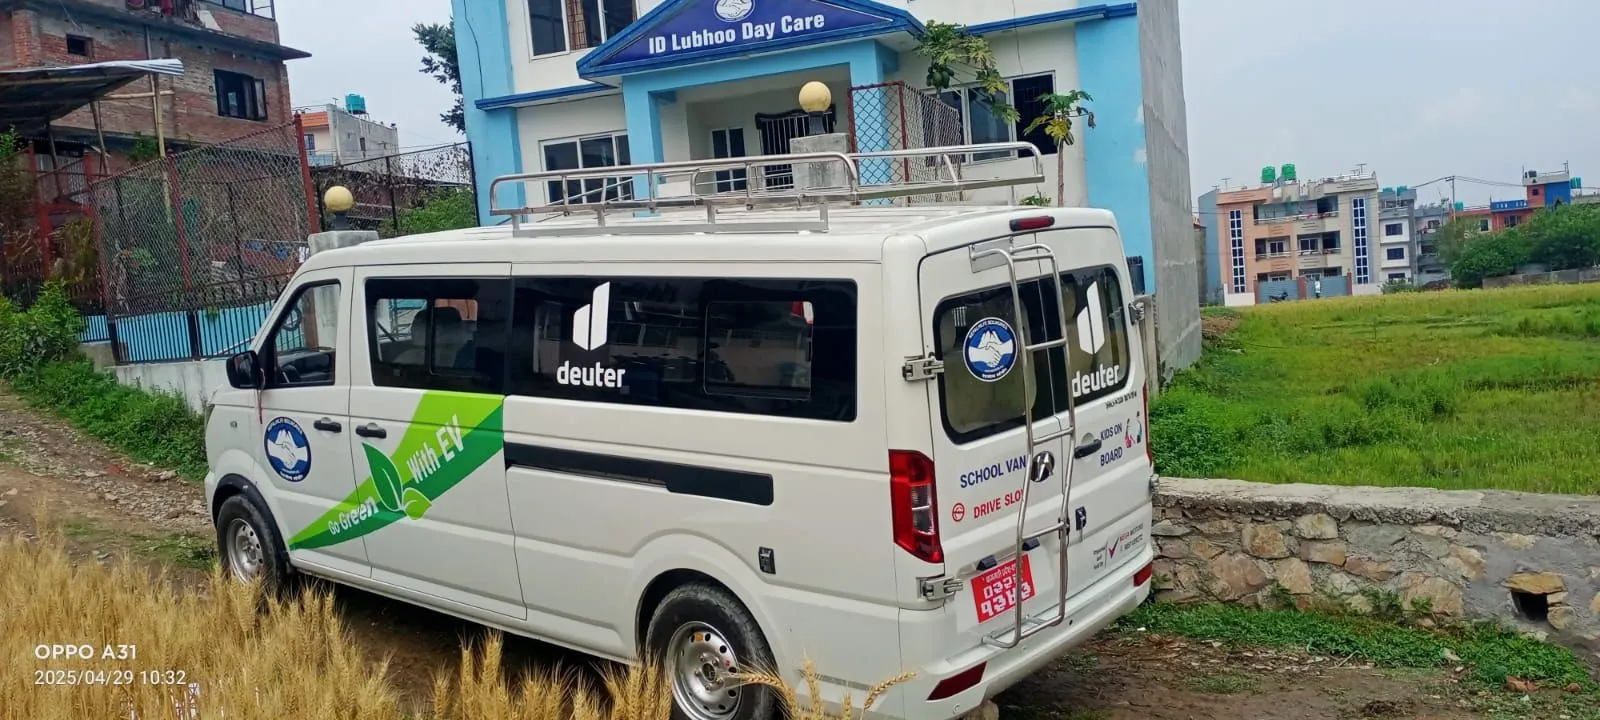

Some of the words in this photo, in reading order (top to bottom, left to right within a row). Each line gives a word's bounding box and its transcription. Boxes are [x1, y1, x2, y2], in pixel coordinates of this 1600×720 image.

[649, 36, 666, 54] ID
[672, 28, 736, 51] Lubhoo
[742, 21, 776, 39] Day
[781, 14, 825, 34] Care
[556, 360, 626, 388] deuter
[1072, 363, 1120, 396] deuter
[1100, 427, 1113, 440] KIDS
[1114, 423, 1122, 434] ON
[960, 465, 1004, 488] SCHOOL
[1006, 455, 1026, 473] VAN
[1100, 447, 1122, 467] BOARD
[328, 520, 339, 535] Go
[338, 496, 379, 531] Green
[406, 441, 441, 484] With
[436, 413, 464, 462] EV
[973, 498, 1001, 519] DRIVE
